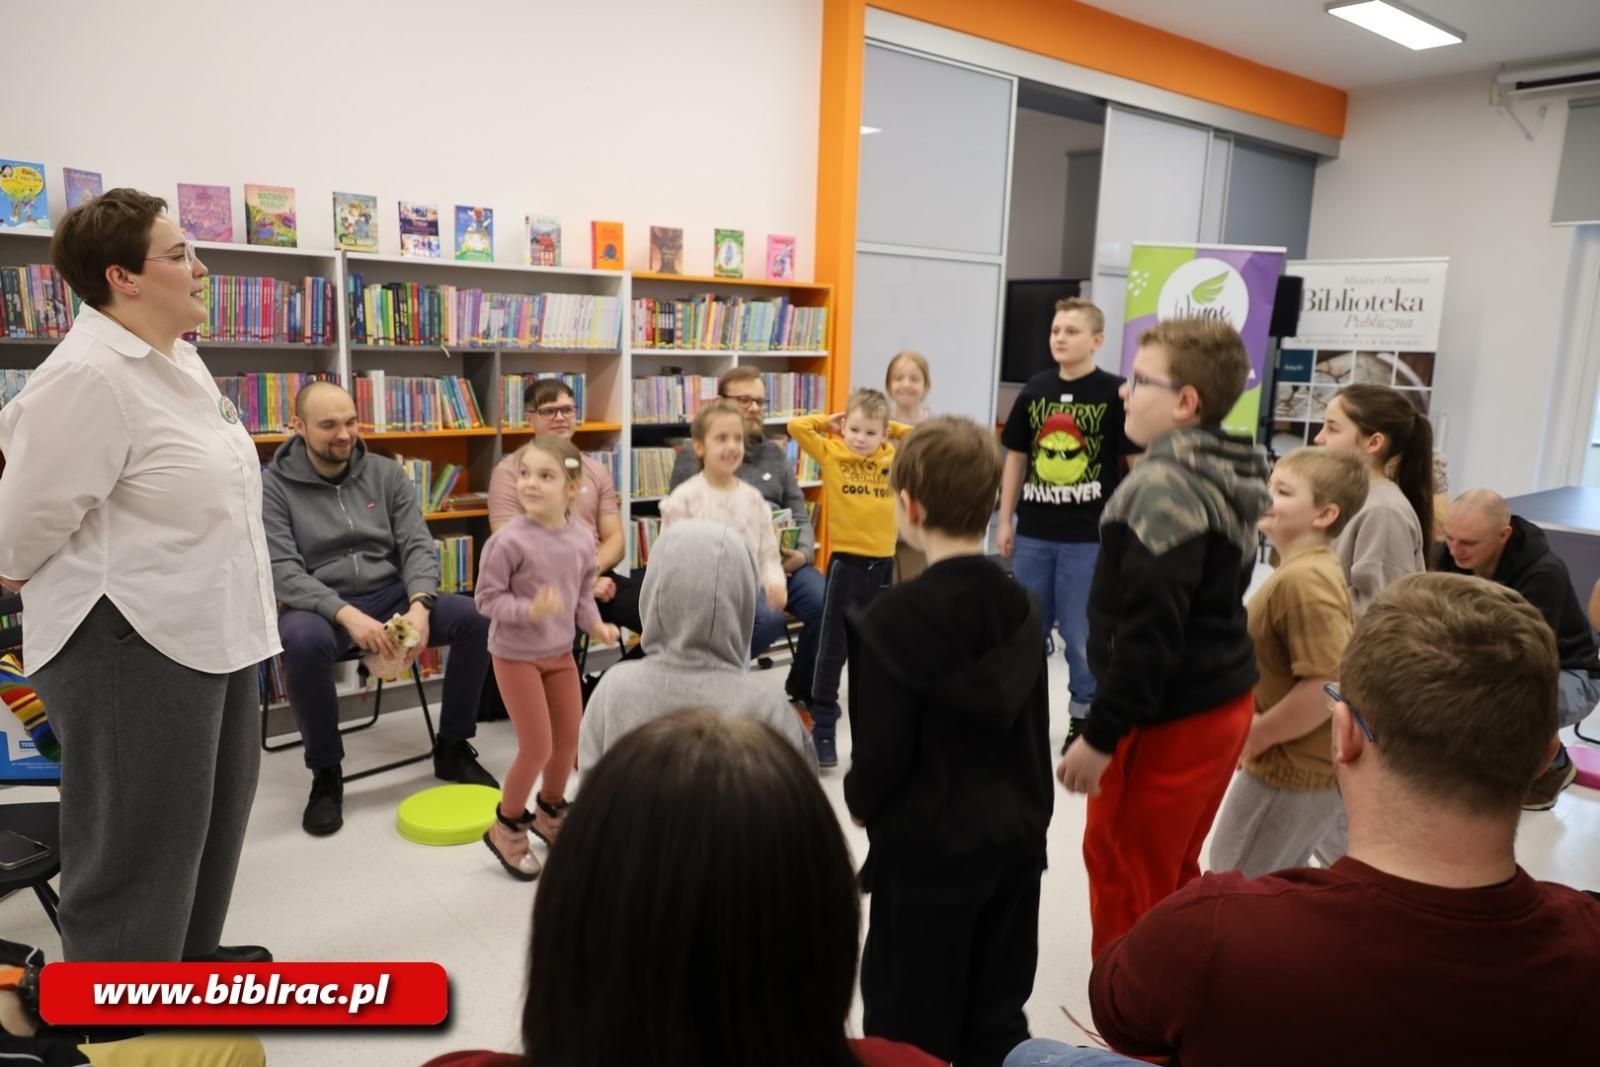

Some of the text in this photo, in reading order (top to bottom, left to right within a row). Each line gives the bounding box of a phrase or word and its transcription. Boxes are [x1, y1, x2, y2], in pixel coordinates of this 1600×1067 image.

[1302, 288, 1424, 312] Biblioteka
[842, 484, 871, 495] COOL
[1023, 480, 1102, 504] WHATEVER
